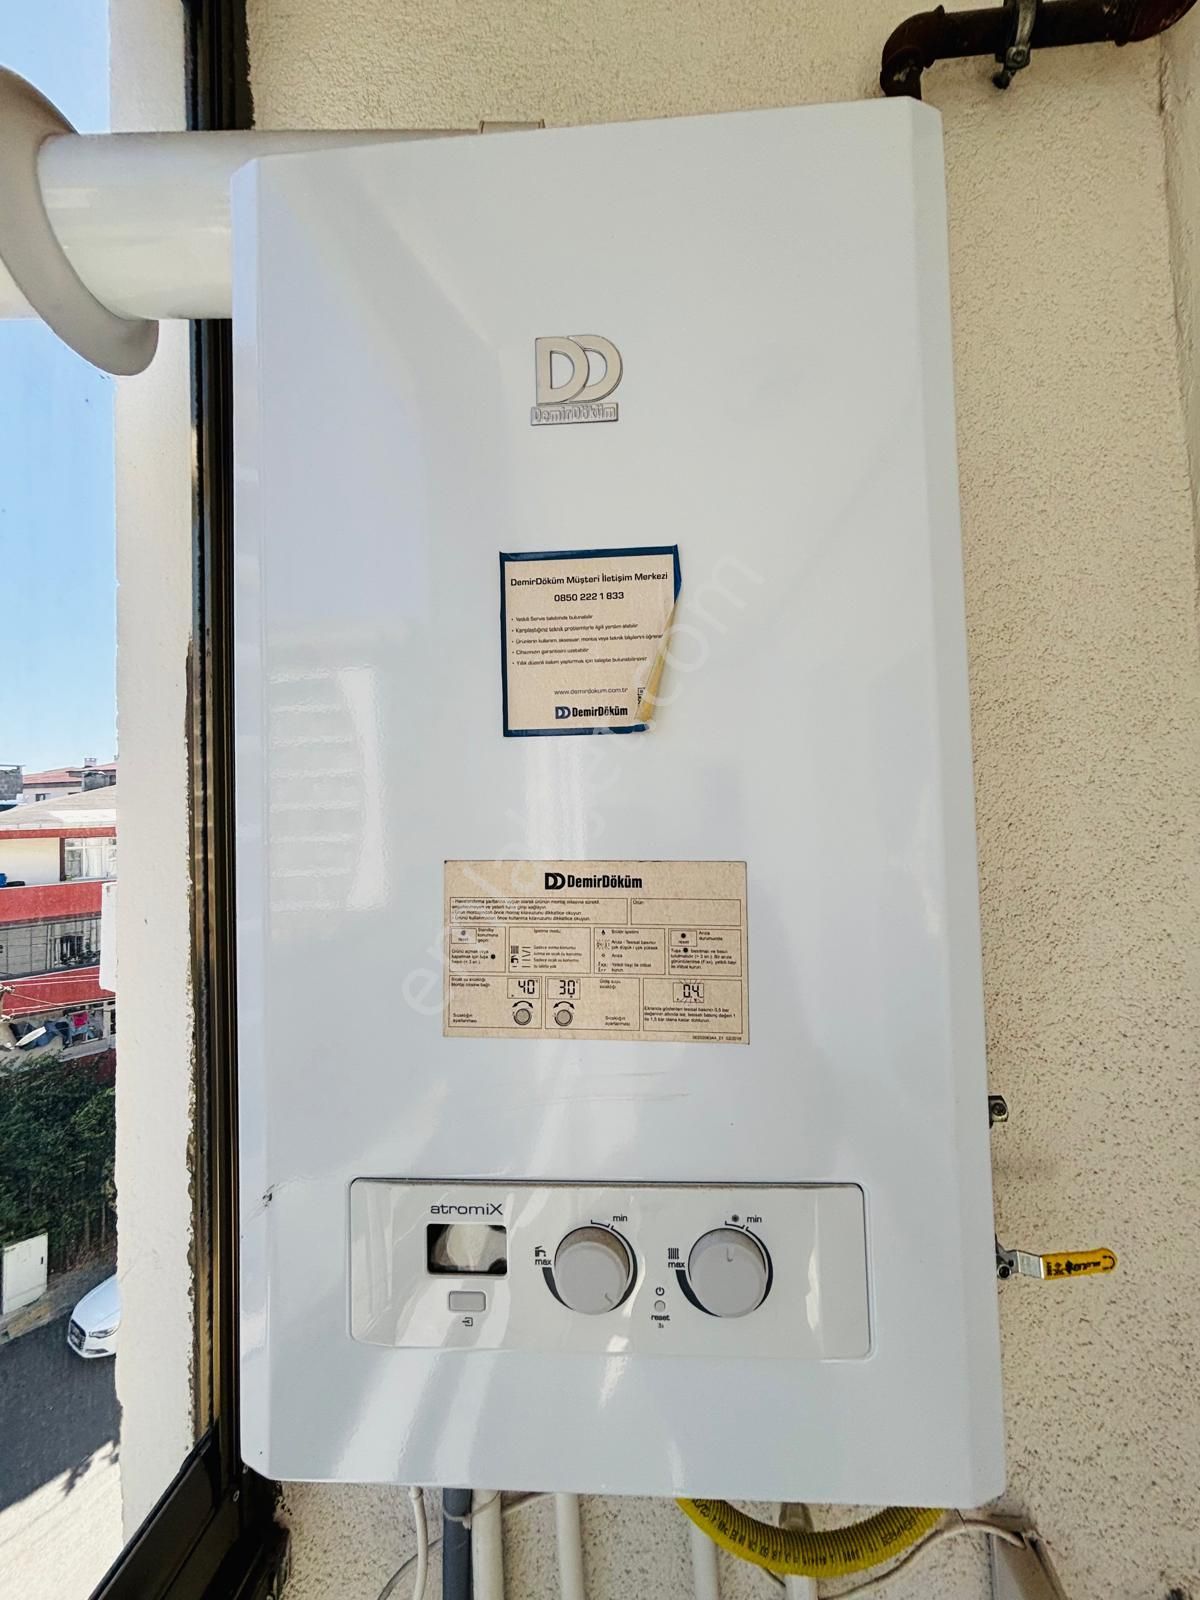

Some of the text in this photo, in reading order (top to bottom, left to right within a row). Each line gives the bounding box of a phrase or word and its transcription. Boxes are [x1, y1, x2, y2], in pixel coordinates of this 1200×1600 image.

[510, 572, 668, 587] DemirDöküm Müşteri İletişim Merkezi
[554, 593, 578, 602] 0850
[580, 592, 598, 601] 222
[606, 591, 625, 600] 833
[572, 706, 628, 718] DemirDöküm
[567, 875, 643, 888] DemirDöküm
[430, 1203, 504, 1216] atromiX
[612, 1214, 628, 1222] min
[746, 1215, 762, 1224] min
[534, 1258, 552, 1266] max
[668, 1261, 686, 1269] max
[650, 1314, 670, 1322] reset
